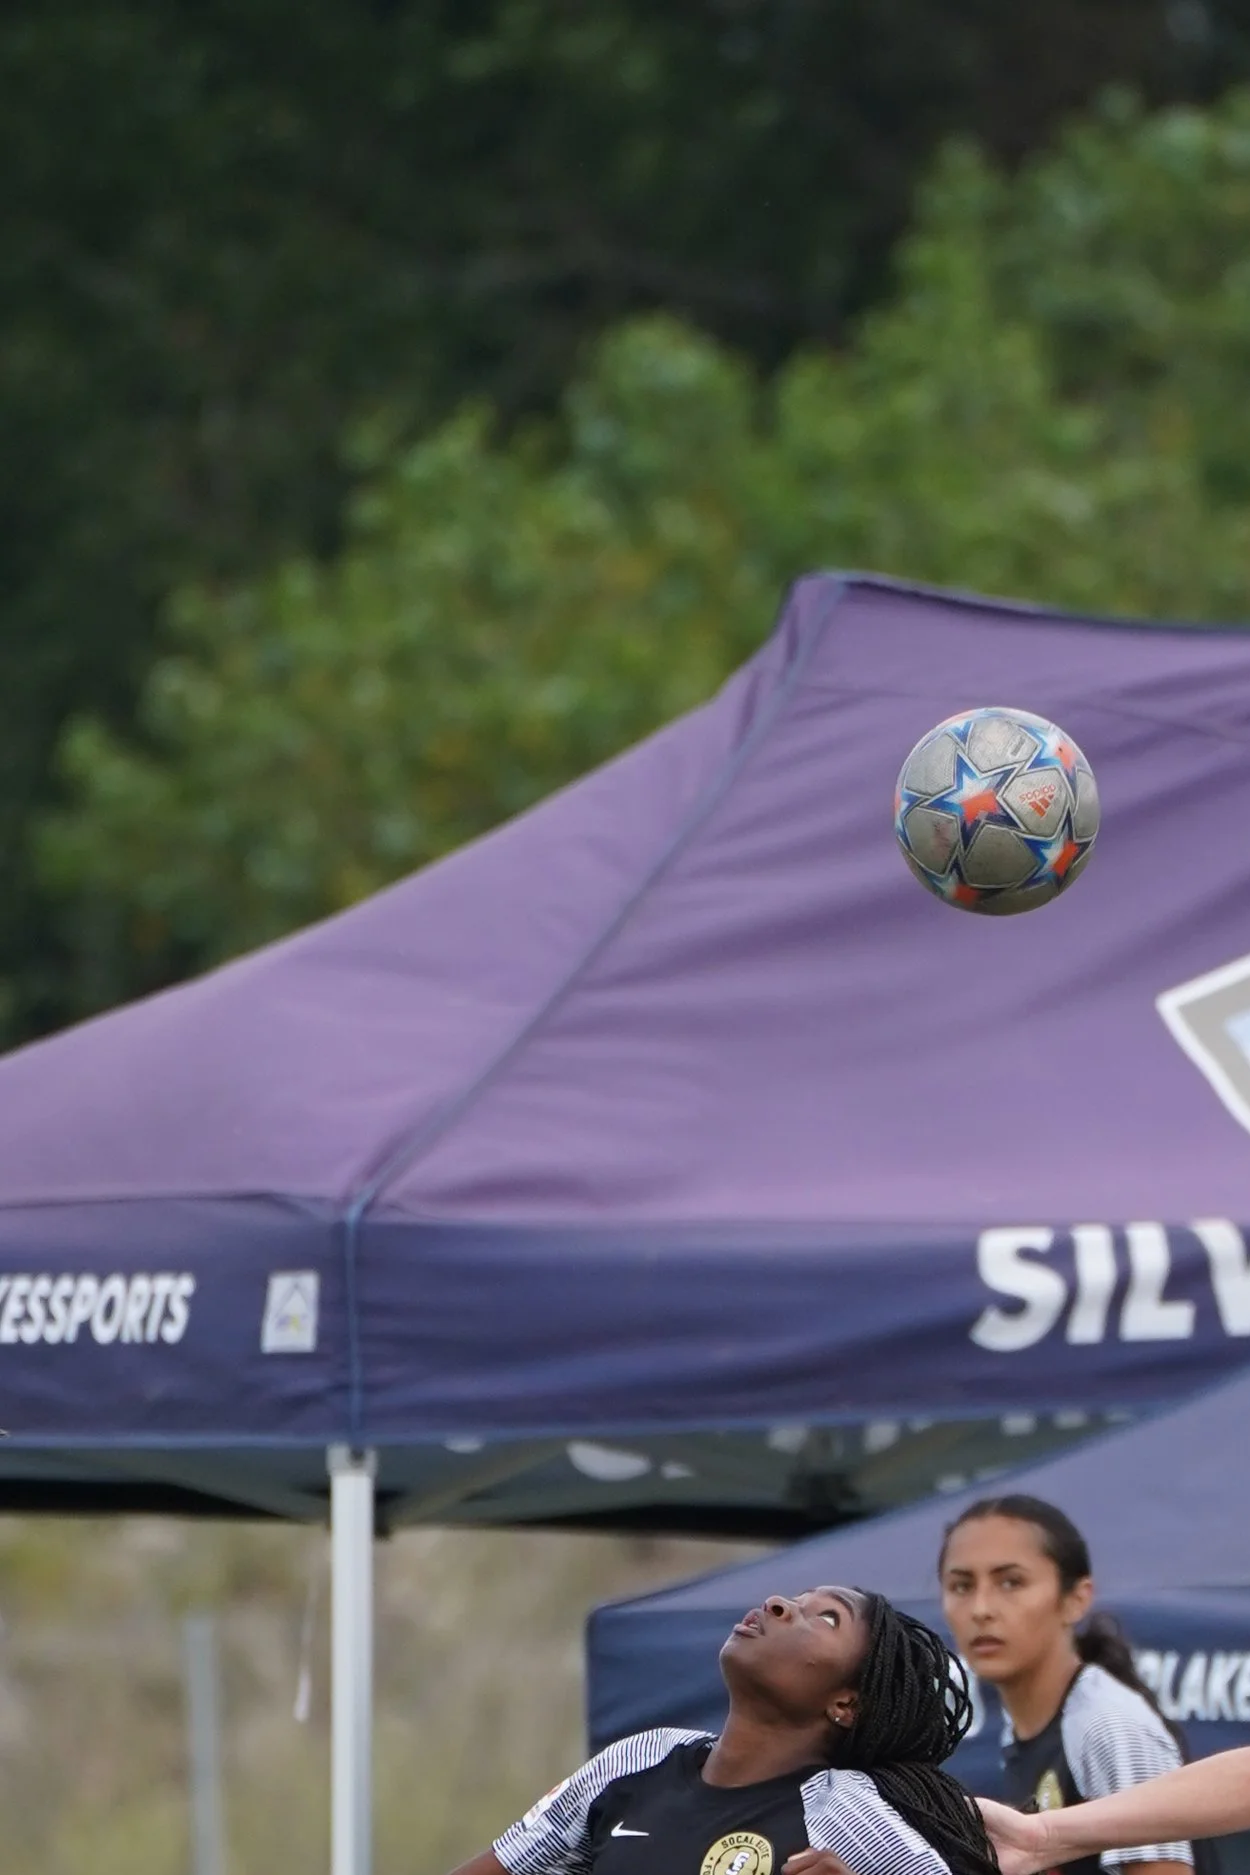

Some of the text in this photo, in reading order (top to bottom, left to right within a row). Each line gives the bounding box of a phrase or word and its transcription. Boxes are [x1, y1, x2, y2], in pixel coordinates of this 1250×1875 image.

[1018, 783, 1057, 804] adidas
[721, 1835, 770, 1860] SOCAL ELITE
